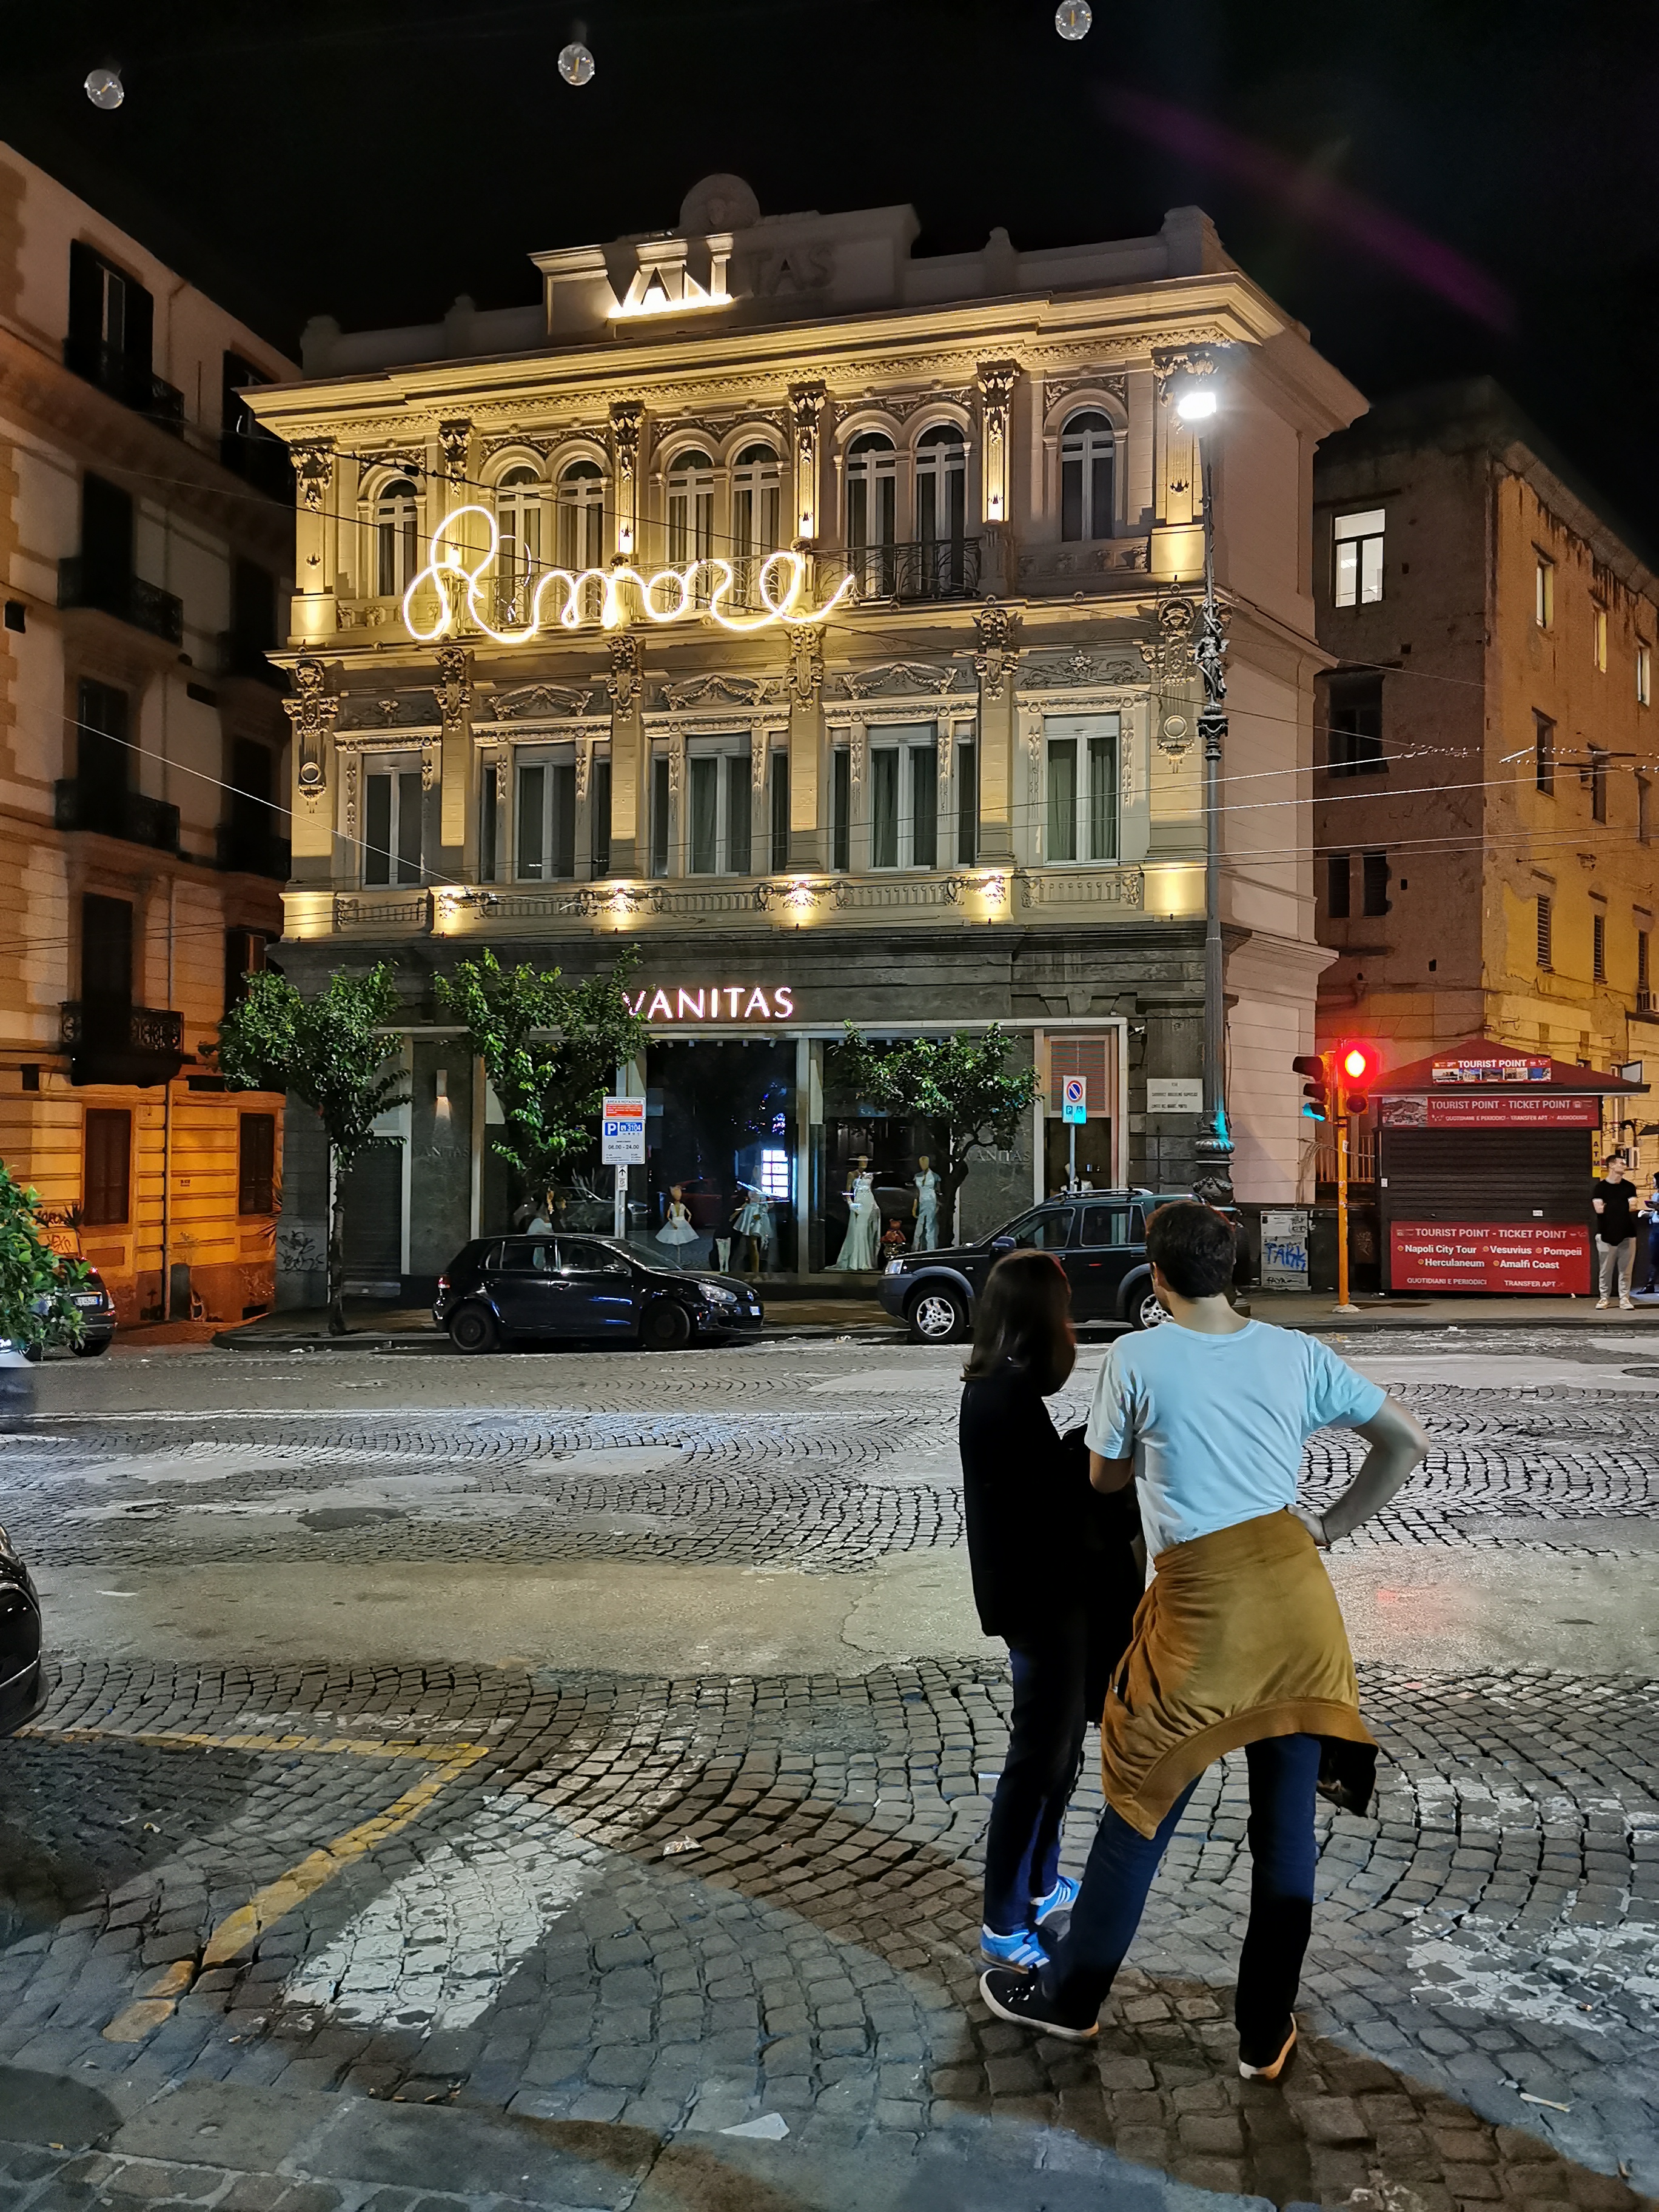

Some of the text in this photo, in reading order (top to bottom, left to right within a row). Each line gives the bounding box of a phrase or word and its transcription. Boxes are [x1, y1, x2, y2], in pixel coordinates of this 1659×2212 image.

[622, 986, 794, 1019] VANITAS
[1458, 1059, 1496, 1068] TOURIST
[1499, 1059, 1527, 1067] POINT
[1431, 1101, 1469, 1109] TOURIST
[1472, 1101, 1500, 1109] POINT
[1509, 1100, 1540, 1109] TICKET
[1543, 1100, 1570, 1108] POINT
[1415, 1228, 1456, 1238] TOURIST
[1459, 1228, 1490, 1238] POINT
[1498, 1229, 1533, 1238] TICKET
[1535, 1230, 1567, 1238] POINT
[1405, 1244, 1434, 1255] Napoli
[1436, 1244, 1454, 1256] City
[1490, 1246, 1532, 1255] Vesuvius
[1543, 1247, 1582, 1256] Pompeii
[1424, 1258, 1485, 1267] Herculaneum
[1500, 1259, 1560, 1269] Amalfi Coast
